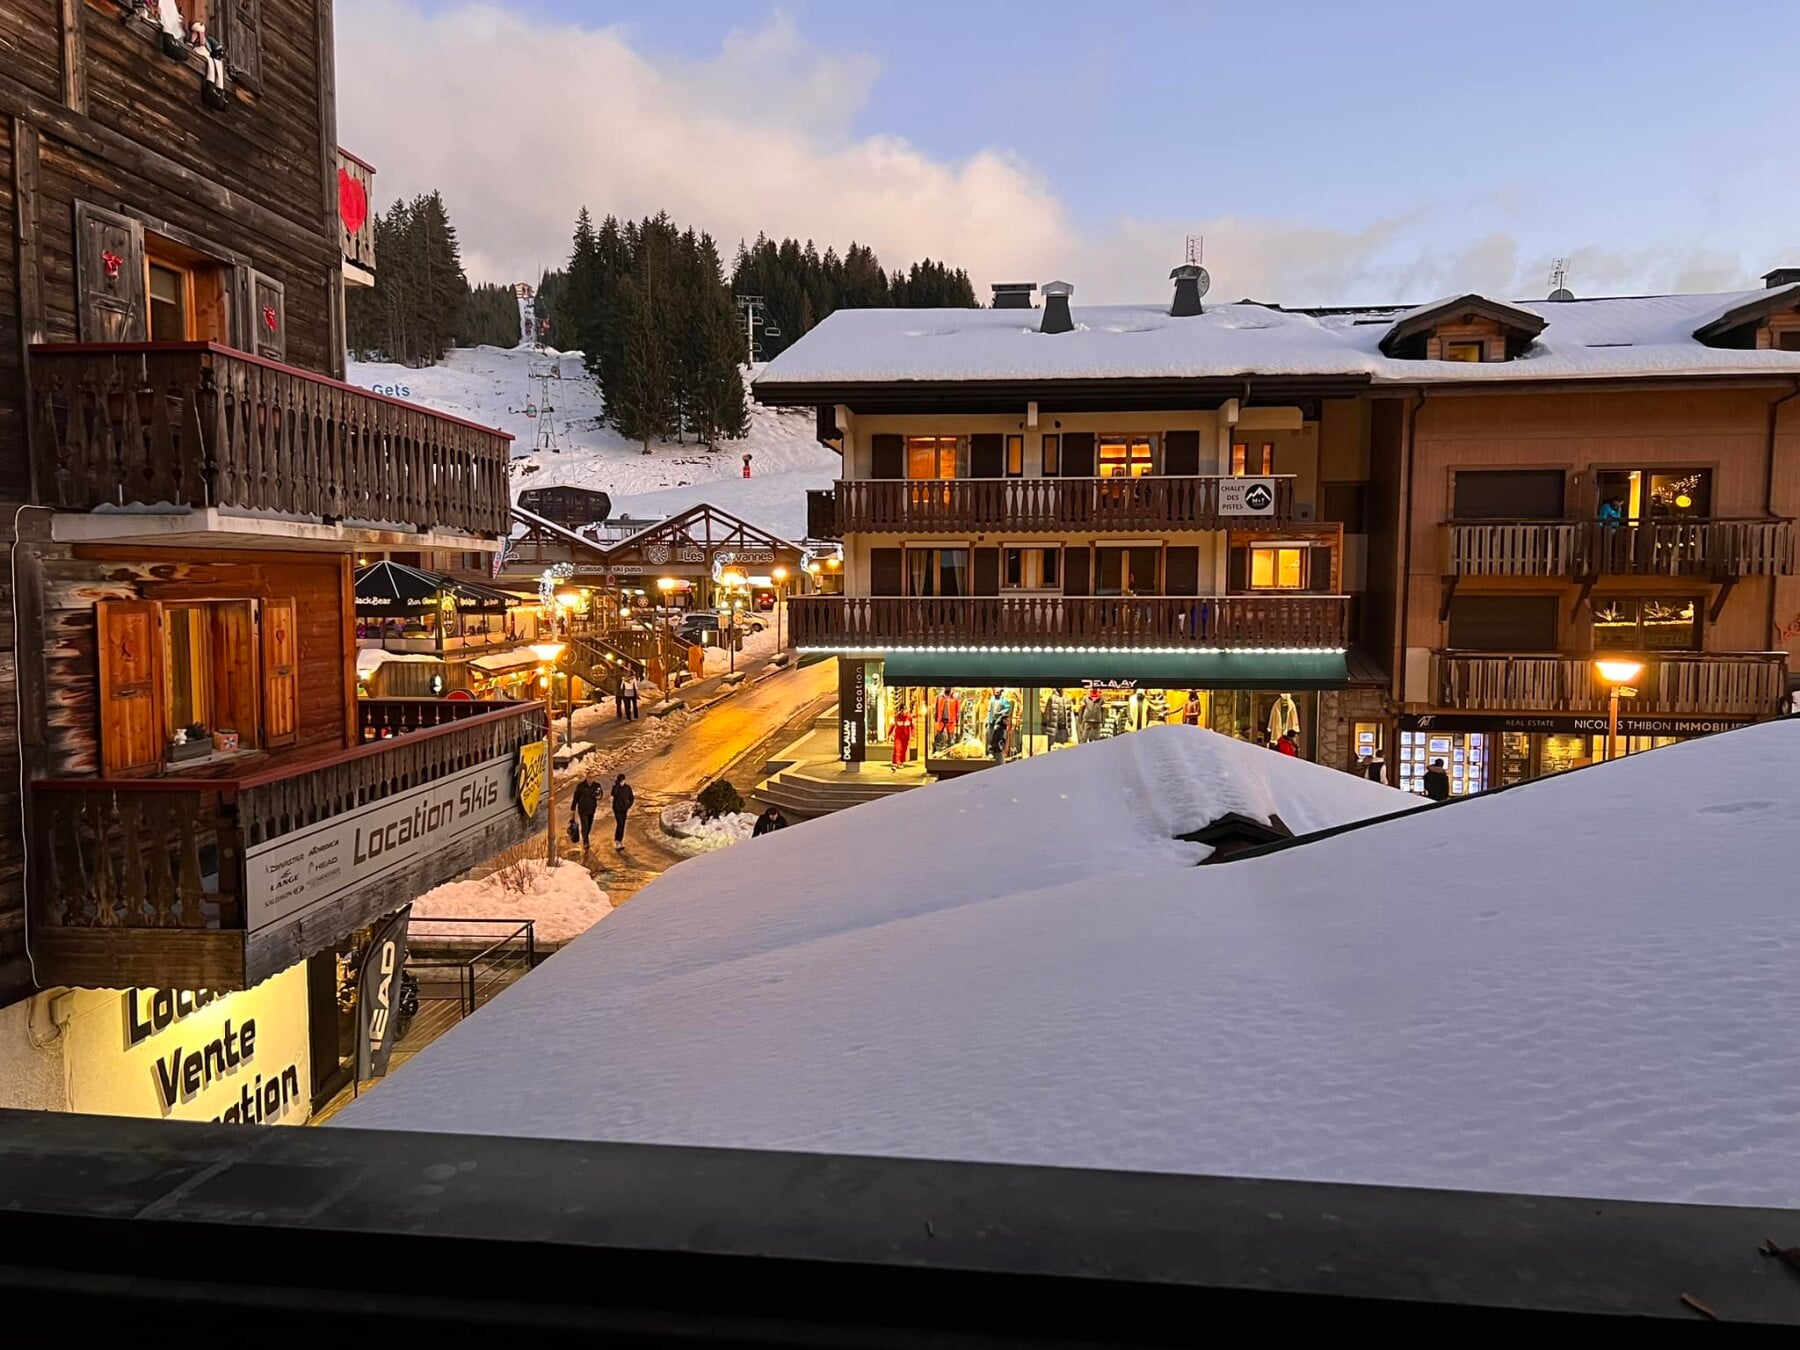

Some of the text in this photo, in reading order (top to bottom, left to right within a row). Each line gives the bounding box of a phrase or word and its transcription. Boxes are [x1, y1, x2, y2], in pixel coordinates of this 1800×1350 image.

[372, 384, 410, 396] Gets
[683, 551, 703, 561] Les
[612, 565, 624, 573] ski
[624, 566, 642, 575] pass
[854, 666, 863, 713] location
[1505, 719, 1555, 727] REAL ESTATE
[1574, 719, 1624, 730] NICOLS
[1627, 720, 1671, 731] THIBON
[353, 775, 498, 866] Location Skis
[315, 856, 338, 871] HEAD
[270, 873, 299, 892] LANGE
[156, 1018, 256, 1108] Vente
